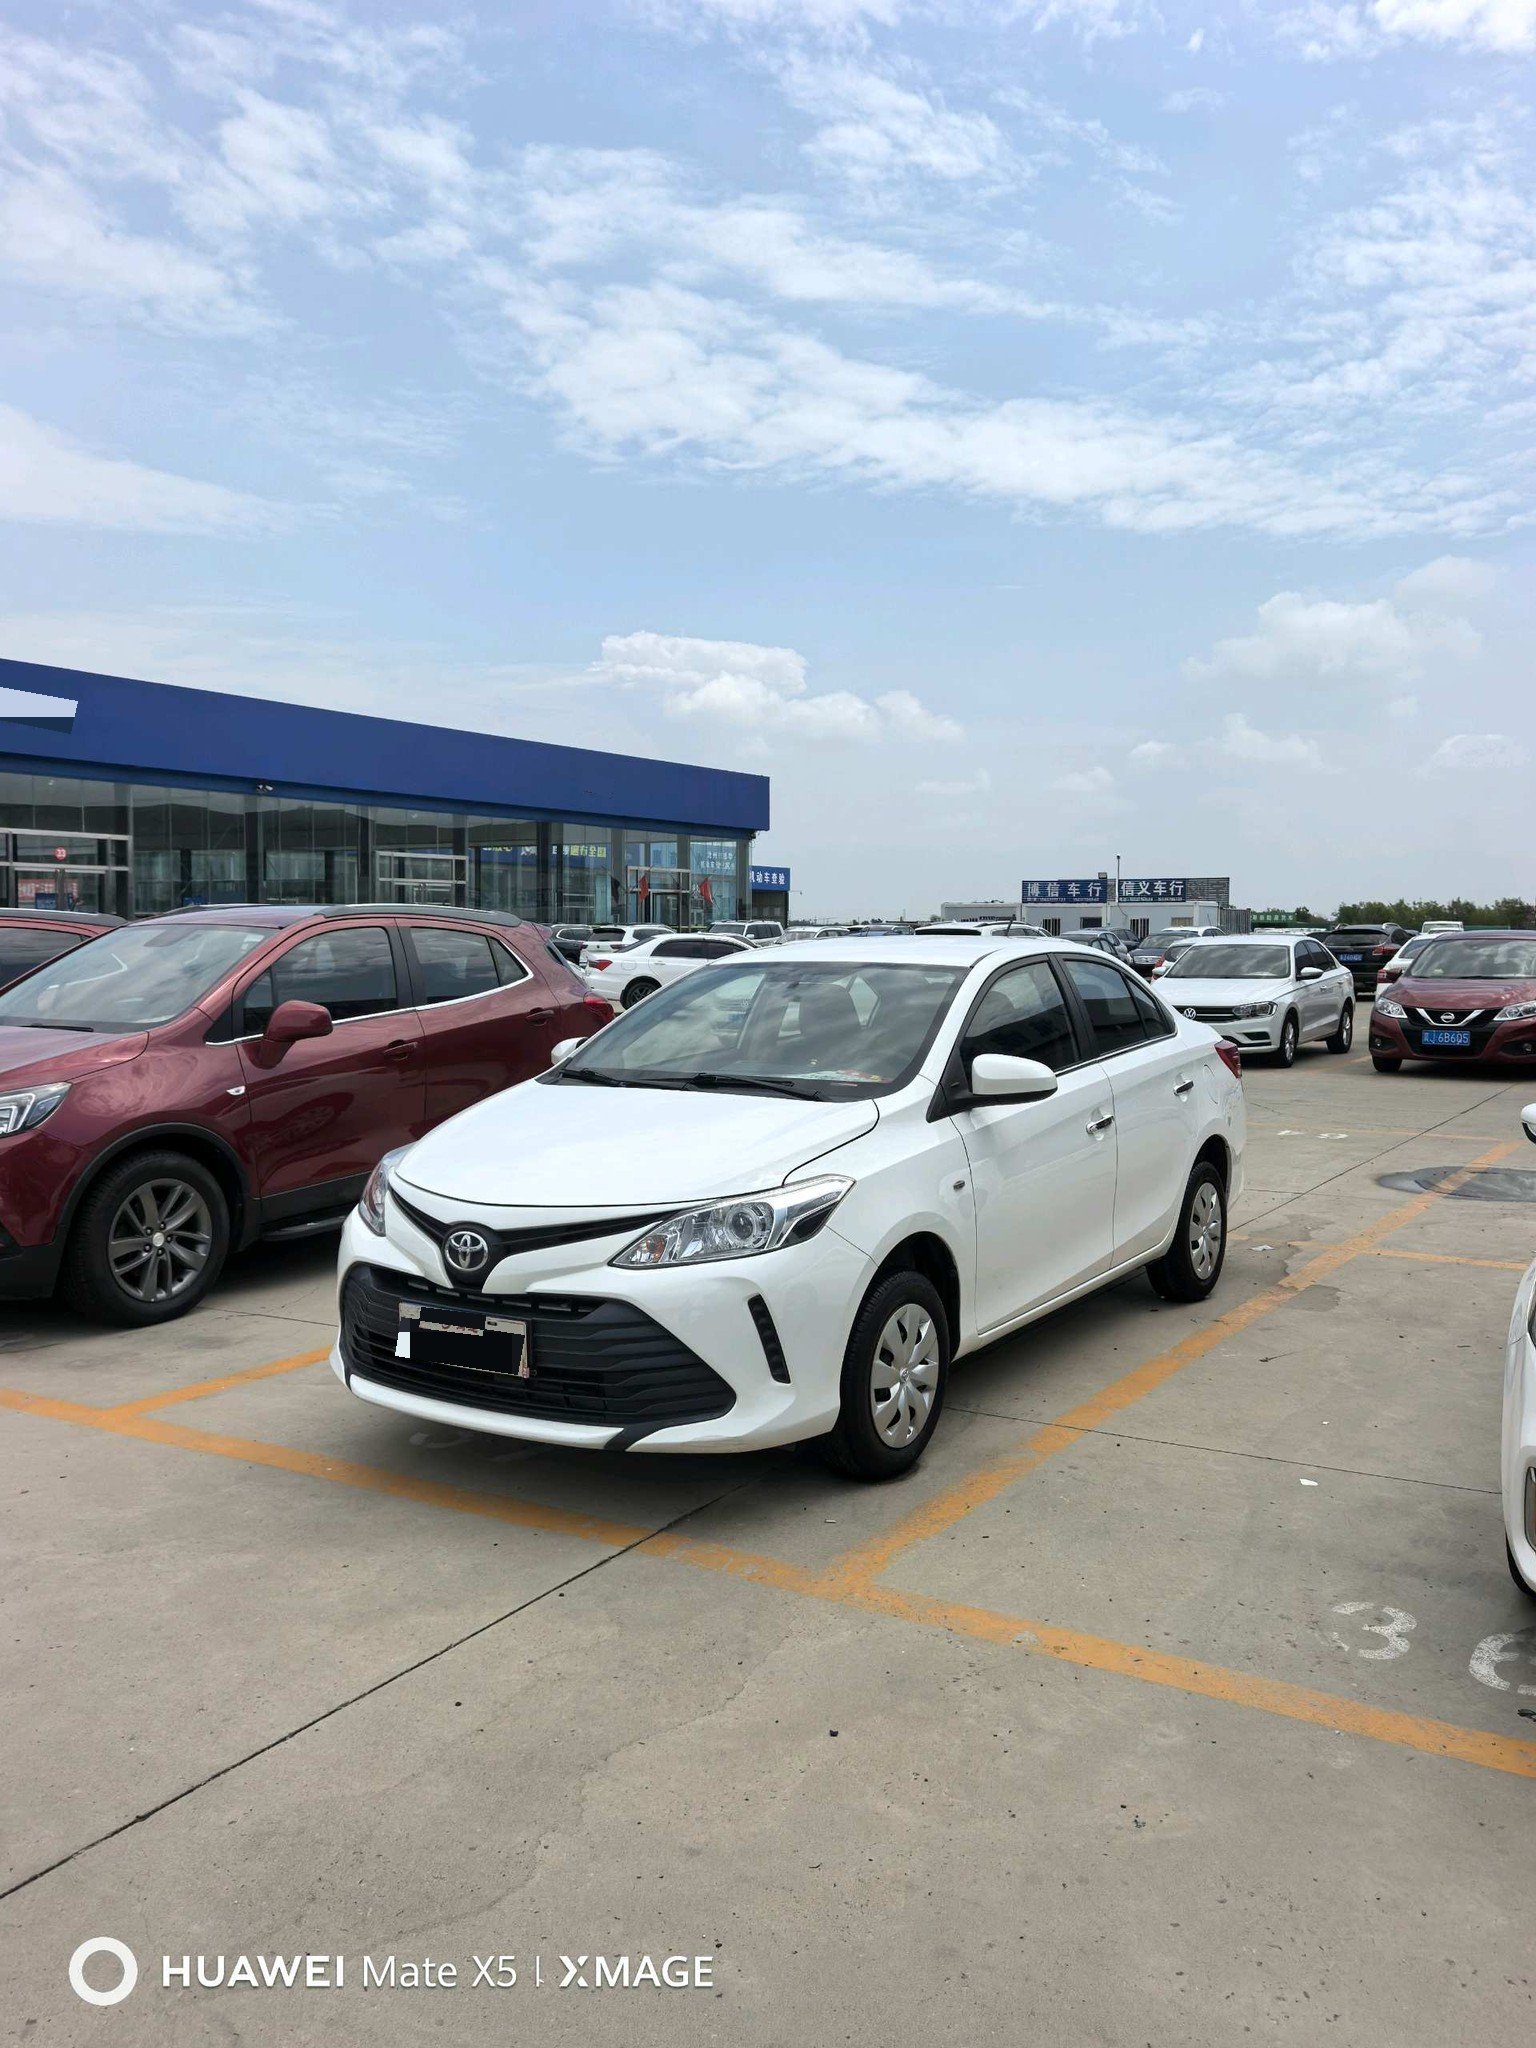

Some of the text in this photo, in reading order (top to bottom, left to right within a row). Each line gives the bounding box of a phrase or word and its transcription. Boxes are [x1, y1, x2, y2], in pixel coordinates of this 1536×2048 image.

[1026, 881, 1102, 897] 博信车行
[1120, 880, 1184, 896] 信义车行
